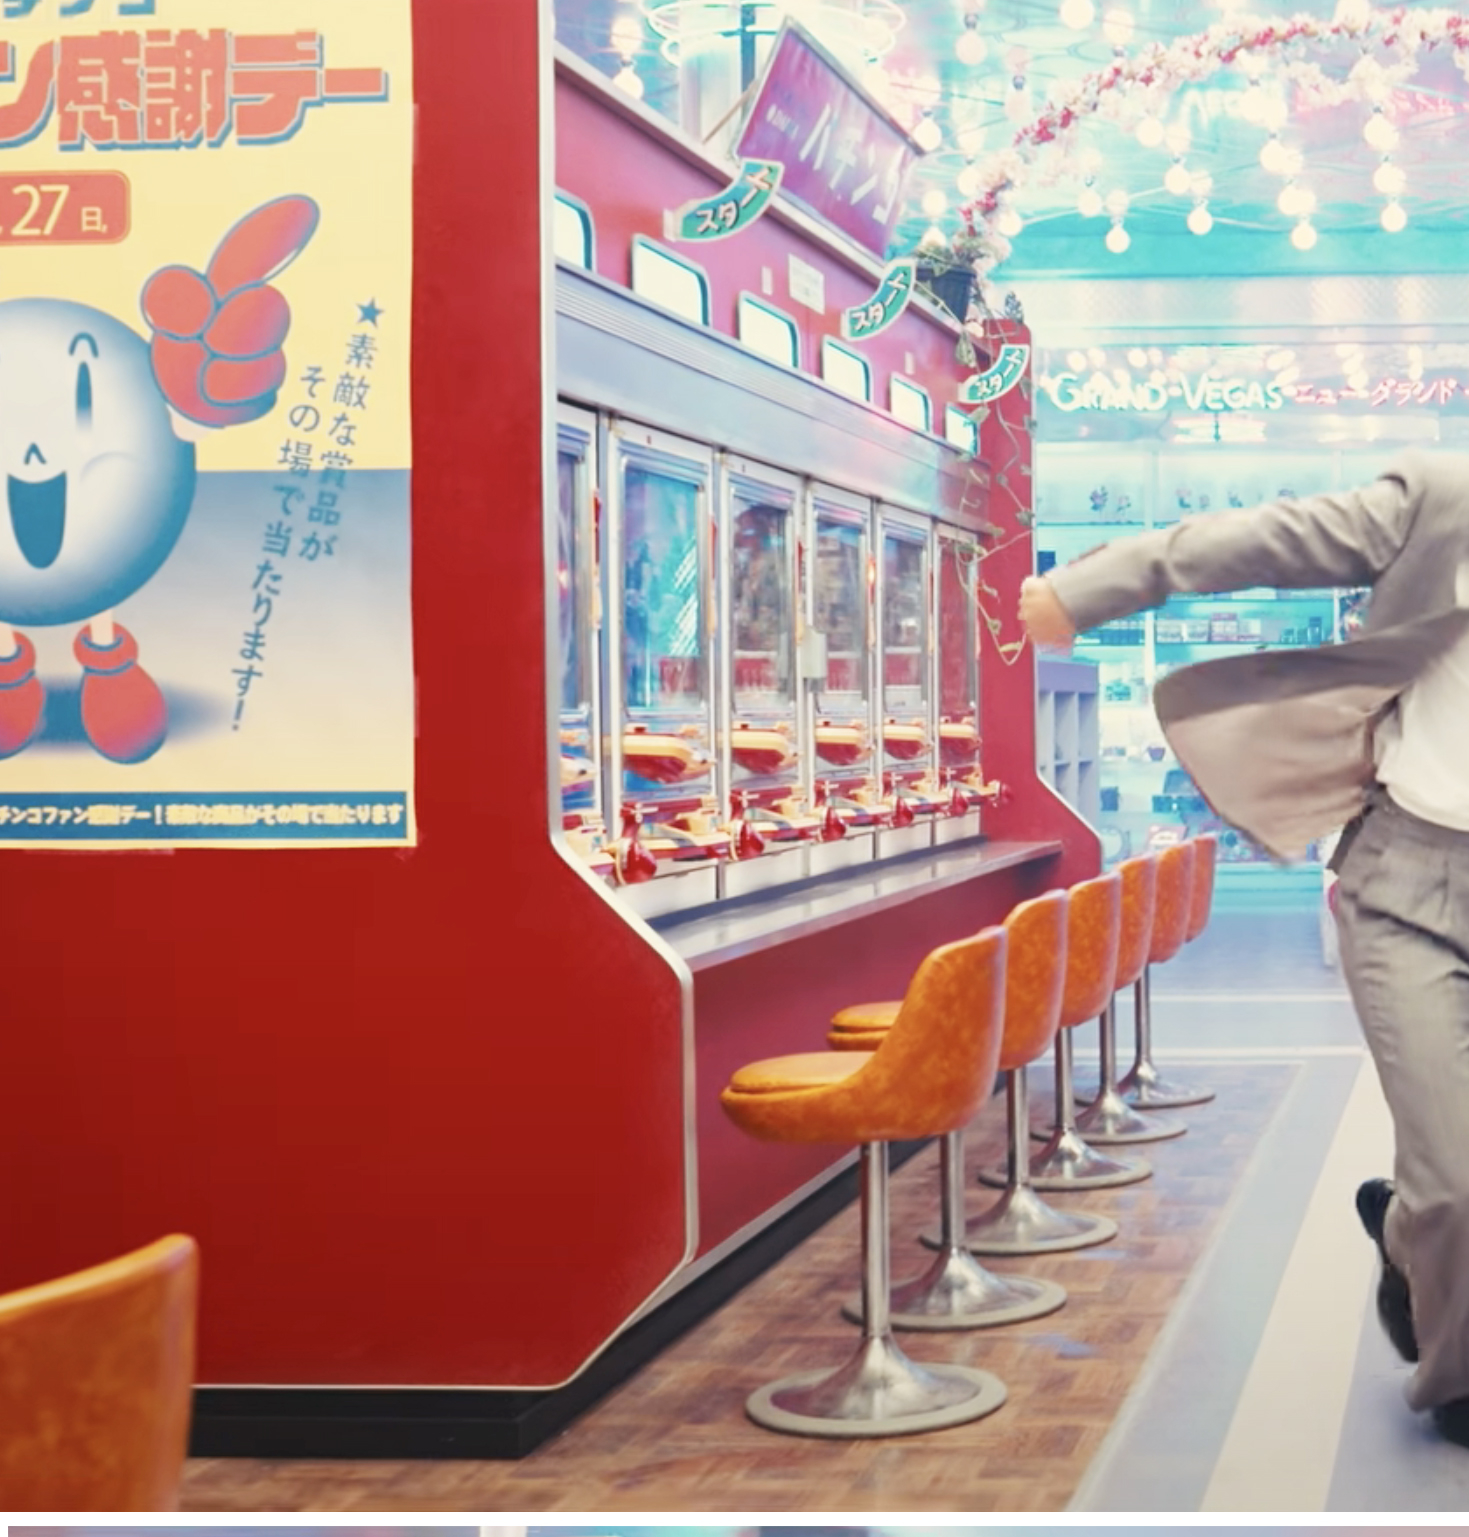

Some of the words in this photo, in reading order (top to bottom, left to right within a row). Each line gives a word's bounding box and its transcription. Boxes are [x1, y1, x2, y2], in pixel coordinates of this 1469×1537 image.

[694, 165, 774, 234] スタート
[851, 272, 907, 331] スタート
[972, 350, 1025, 396] スタート
[299, 332, 379, 562] 素敵な賞品が
